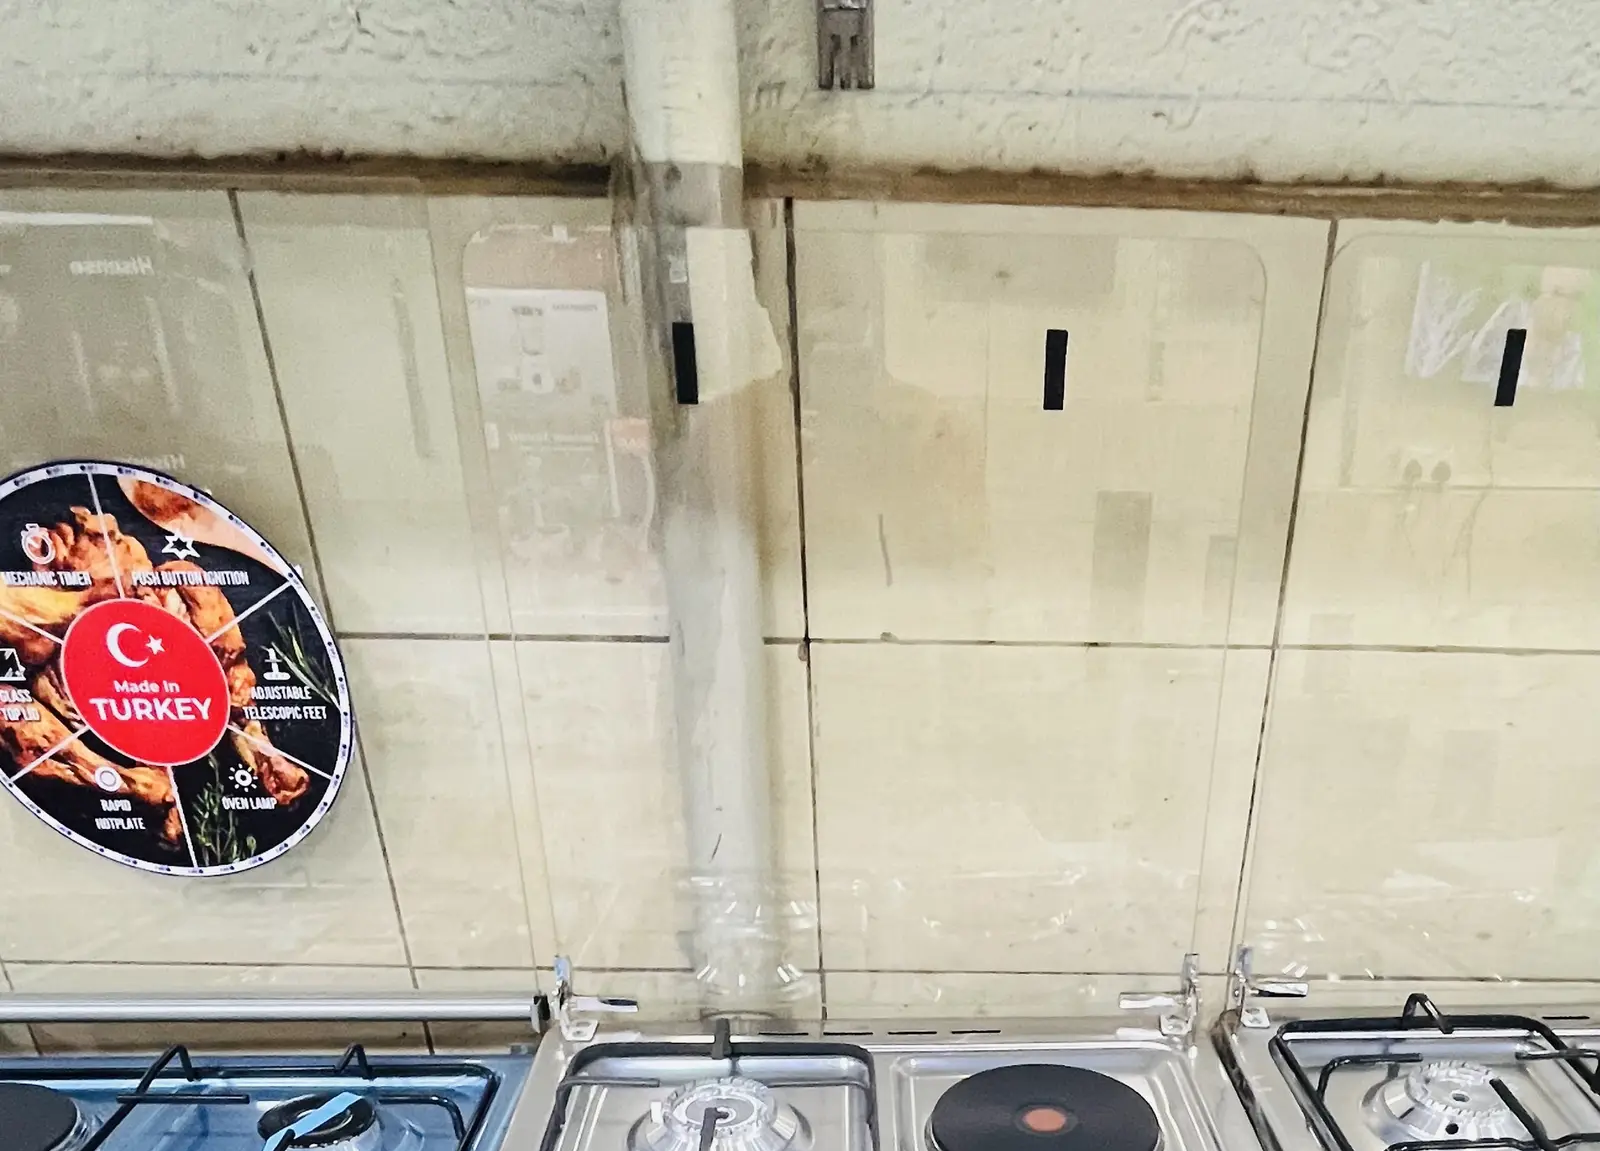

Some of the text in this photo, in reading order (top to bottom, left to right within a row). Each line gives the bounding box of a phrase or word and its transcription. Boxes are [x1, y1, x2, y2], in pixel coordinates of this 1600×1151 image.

[1, 571, 92, 586] MECHANIC TIMER
[132, 571, 250, 586] PUSH BUTTON IGNITION
[113, 680, 160, 693] Made
[250, 686, 312, 700] ADJUSTABLE
[89, 698, 212, 721] TURKEY
[242, 706, 327, 720] TELESCOPIC FEET
[100, 799, 132, 812] RAPID
[222, 797, 278, 810] OVEN LAMP
[95, 817, 146, 830] HOTPLATE
